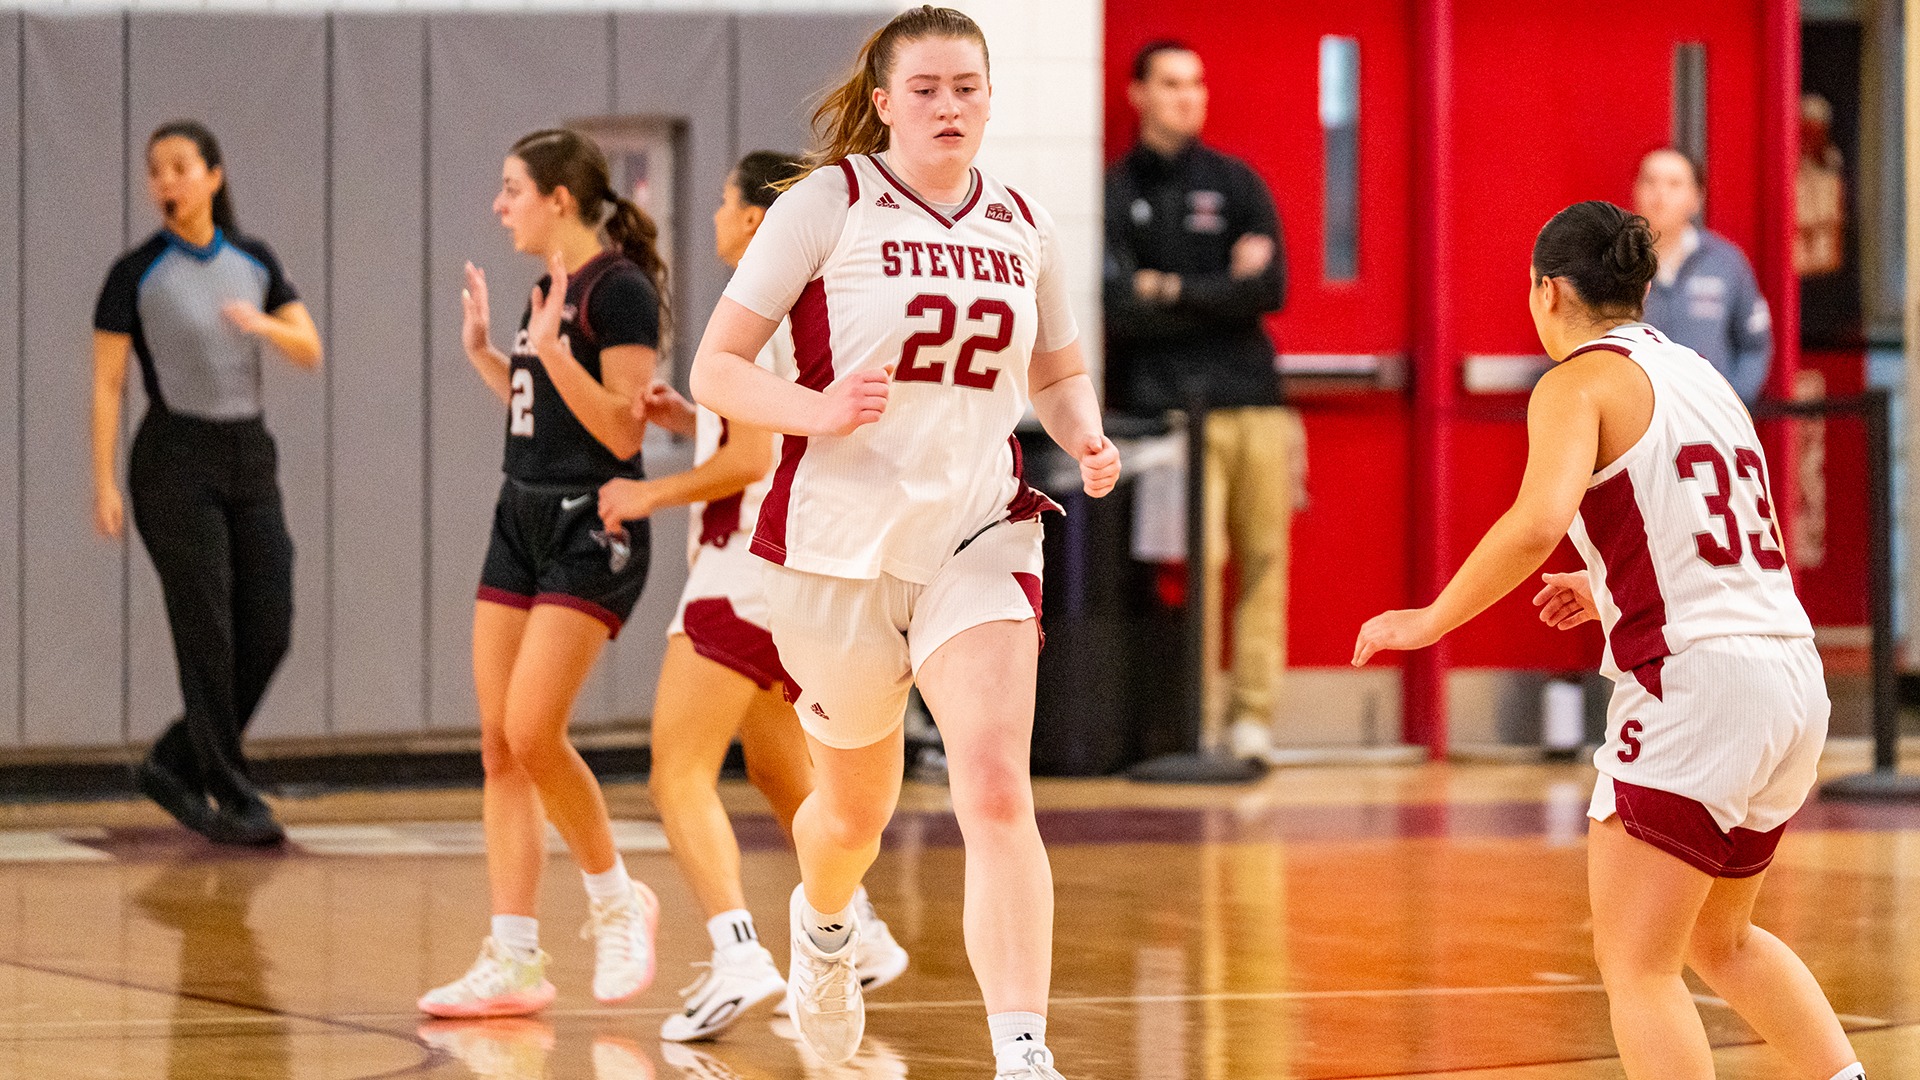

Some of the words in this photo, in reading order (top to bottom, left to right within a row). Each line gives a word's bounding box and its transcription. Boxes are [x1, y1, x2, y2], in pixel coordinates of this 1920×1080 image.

[986, 210, 1012, 221] MAC
[881, 240, 1026, 288] STEVENS
[893, 292, 1016, 392] 22
[1672, 441, 1787, 573] 33
[1616, 718, 1644, 765] S
